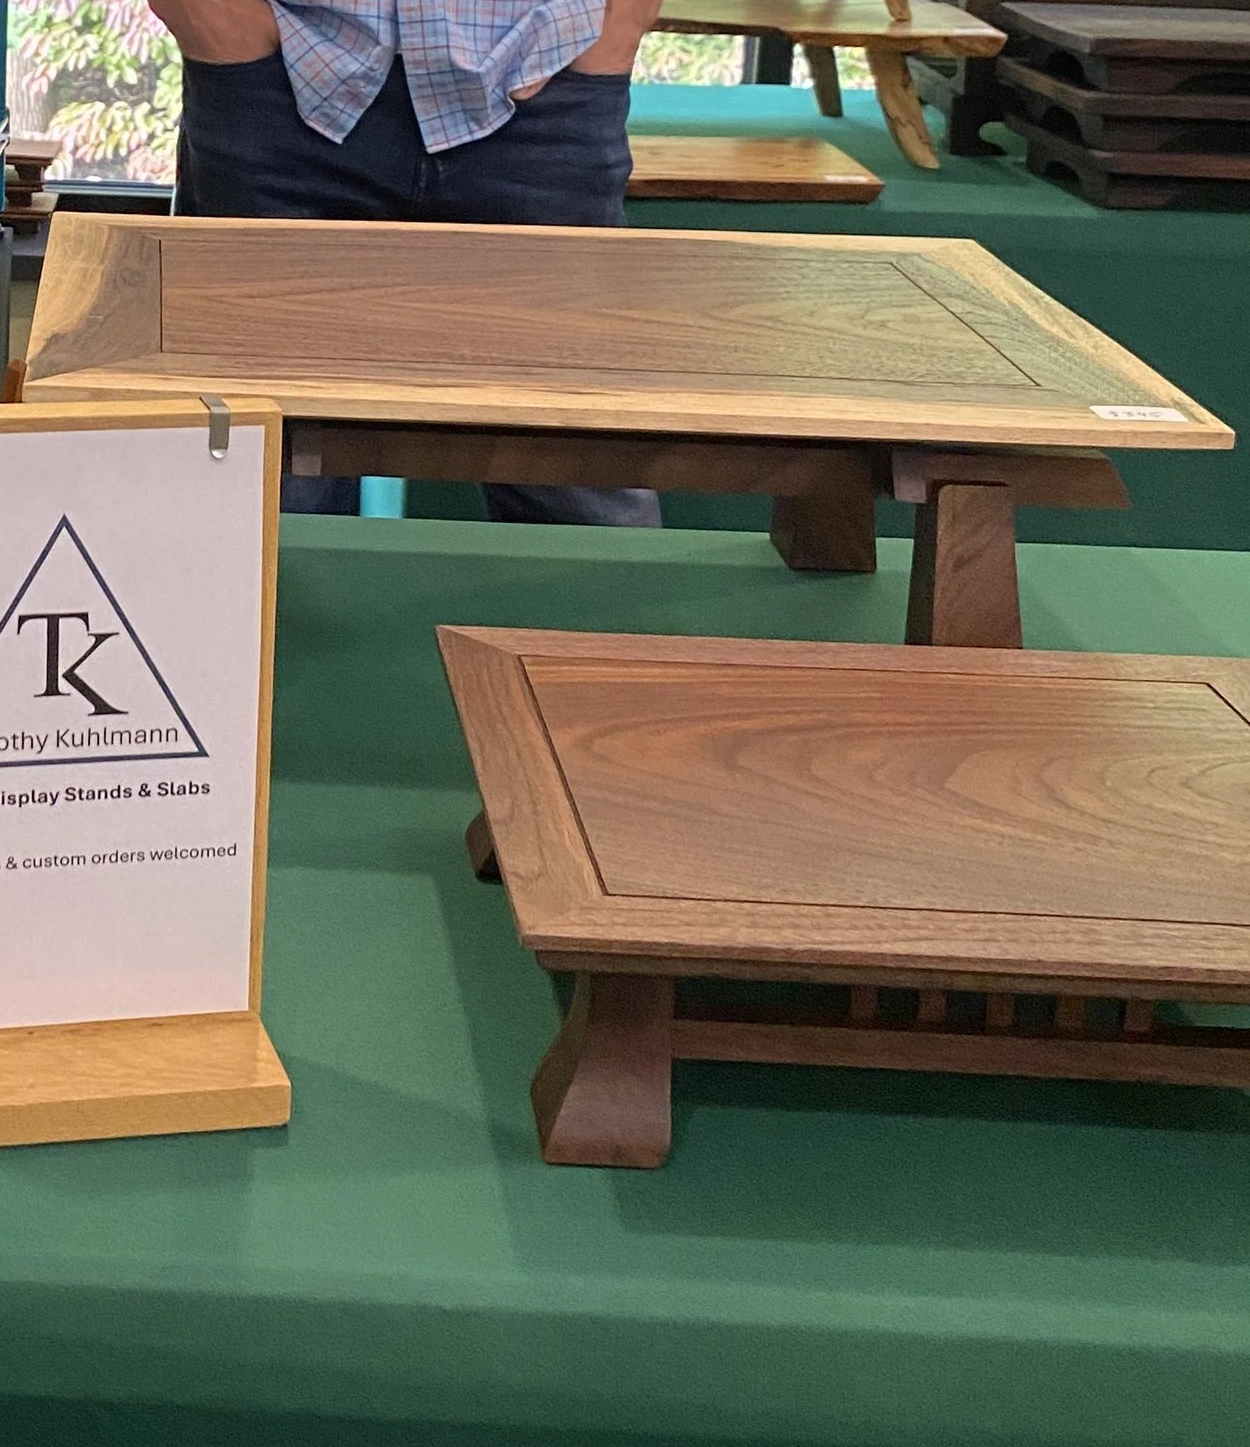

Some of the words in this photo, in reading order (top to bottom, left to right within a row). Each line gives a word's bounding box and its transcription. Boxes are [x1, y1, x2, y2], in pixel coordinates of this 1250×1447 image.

[17, 611, 129, 716] TK
[56, 726, 178, 748] Kuhlmann
[65, 784, 132, 802] Stands
[138, 783, 151, 797] &
[157, 781, 211, 796] Slabs
[6, 856, 17, 870] &
[22, 855, 86, 869] custom
[91, 850, 145, 865] orders
[149, 843, 237, 861] welcomed
